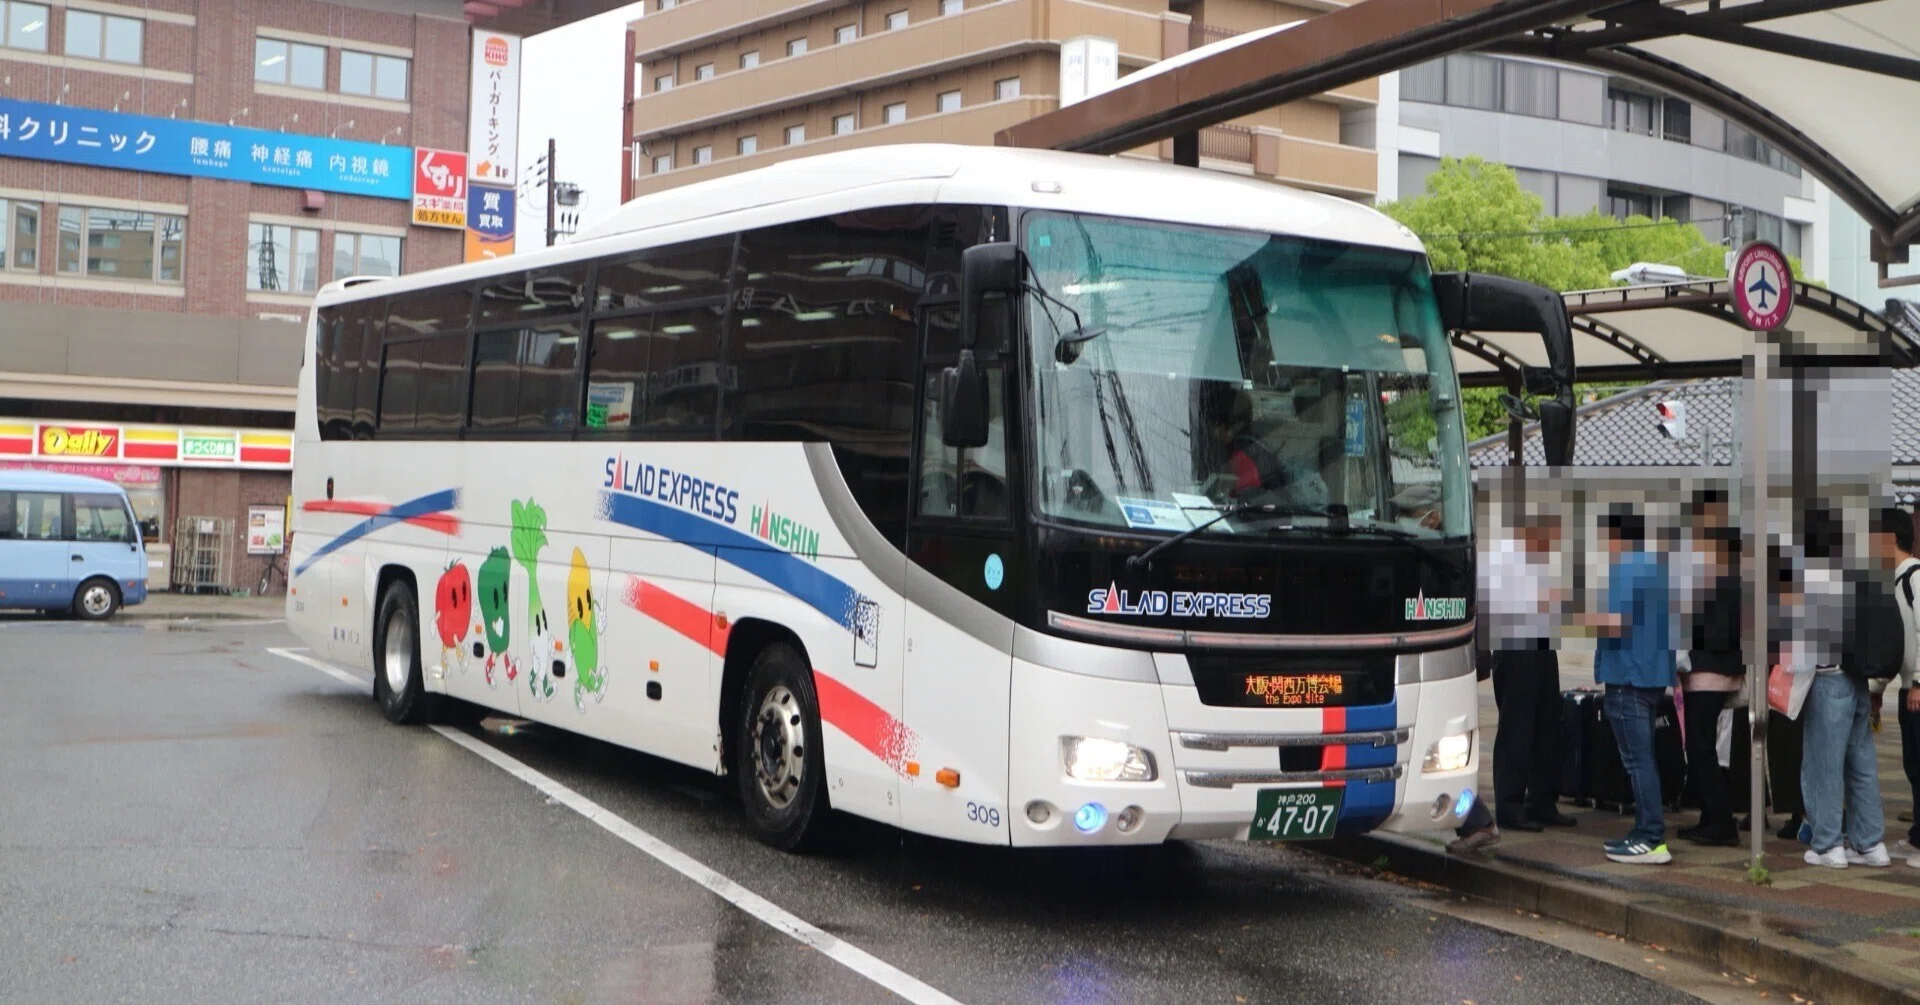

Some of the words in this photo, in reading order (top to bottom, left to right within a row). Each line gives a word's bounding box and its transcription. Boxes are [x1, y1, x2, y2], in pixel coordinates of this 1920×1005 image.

[488, 70, 501, 156] バーガーキング
[190, 136, 232, 159] 腰痛
[251, 143, 313, 169] 神経痛
[330, 153, 389, 177] 内視鏡
[420, 151, 463, 198] くすり
[418, 198, 464, 212] スギ薬局
[418, 210, 461, 225] 処方せん
[479, 213, 503, 229] 買取
[43, 426, 115, 456] Daily
[604, 450, 655, 496] SALAD
[658, 468, 739, 524] EXPRESS
[750, 499, 819, 561] HANSHIN
[1088, 580, 1168, 616] SALAD
[1171, 592, 1271, 618] EXPRESS
[1405, 587, 1466, 620] HANSHIN
[1265, 693, 1280, 704] the
[1283, 694, 1302, 705] Expo
[1305, 693, 1325, 704] Site
[967, 802, 1000, 827] 309
[1267, 805, 1334, 836] 47-07
